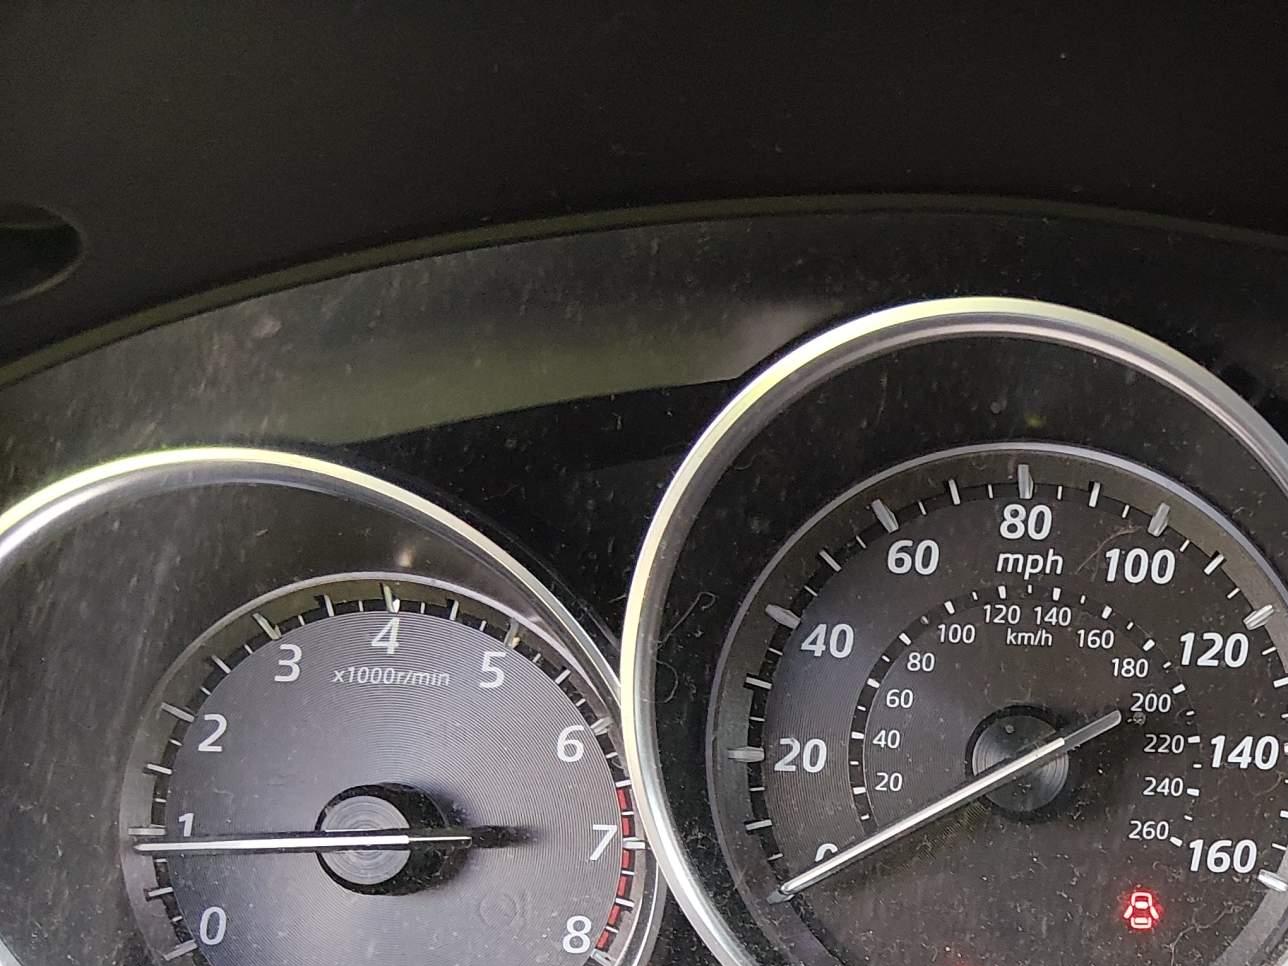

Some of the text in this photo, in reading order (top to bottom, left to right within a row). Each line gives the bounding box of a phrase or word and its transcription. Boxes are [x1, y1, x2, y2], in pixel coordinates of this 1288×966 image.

[999, 503, 1051, 540] 80
[887, 539, 940, 575] 60
[996, 549, 1063, 580] mph
[1105, 548, 1176, 585] 100
[983, 604, 1021, 625] 120
[1034, 606, 1072, 626] 140
[371, 615, 401, 655] 4
[800, 622, 854, 659] 40
[938, 623, 976, 644] 100
[1006, 627, 1053, 647] km/h
[1077, 629, 1115, 649] 160
[274, 643, 302, 682] 3
[907, 652, 935, 672] 80
[1179, 632, 1249, 668] 120
[331, 664, 452, 687] x1000r/min
[479, 651, 507, 689] 5
[1111, 658, 1149, 678] 180
[886, 689, 914, 709] 60
[1130, 692, 1171, 713] 200
[197, 713, 228, 752] 2
[556, 723, 585, 763] 6
[872, 729, 901, 749] 40
[1143, 734, 1185, 754] 220
[774, 737, 828, 774] 20
[1209, 735, 1279, 770] 140
[874, 772, 903, 792] 20
[1142, 776, 1184, 797] 240
[178, 812, 195, 837] 1
[1128, 820, 1170, 841] 260
[588, 821, 618, 862] 7
[1188, 838, 1258, 875] 160
[199, 906, 228, 946] 0
[562, 915, 593, 955] 8
